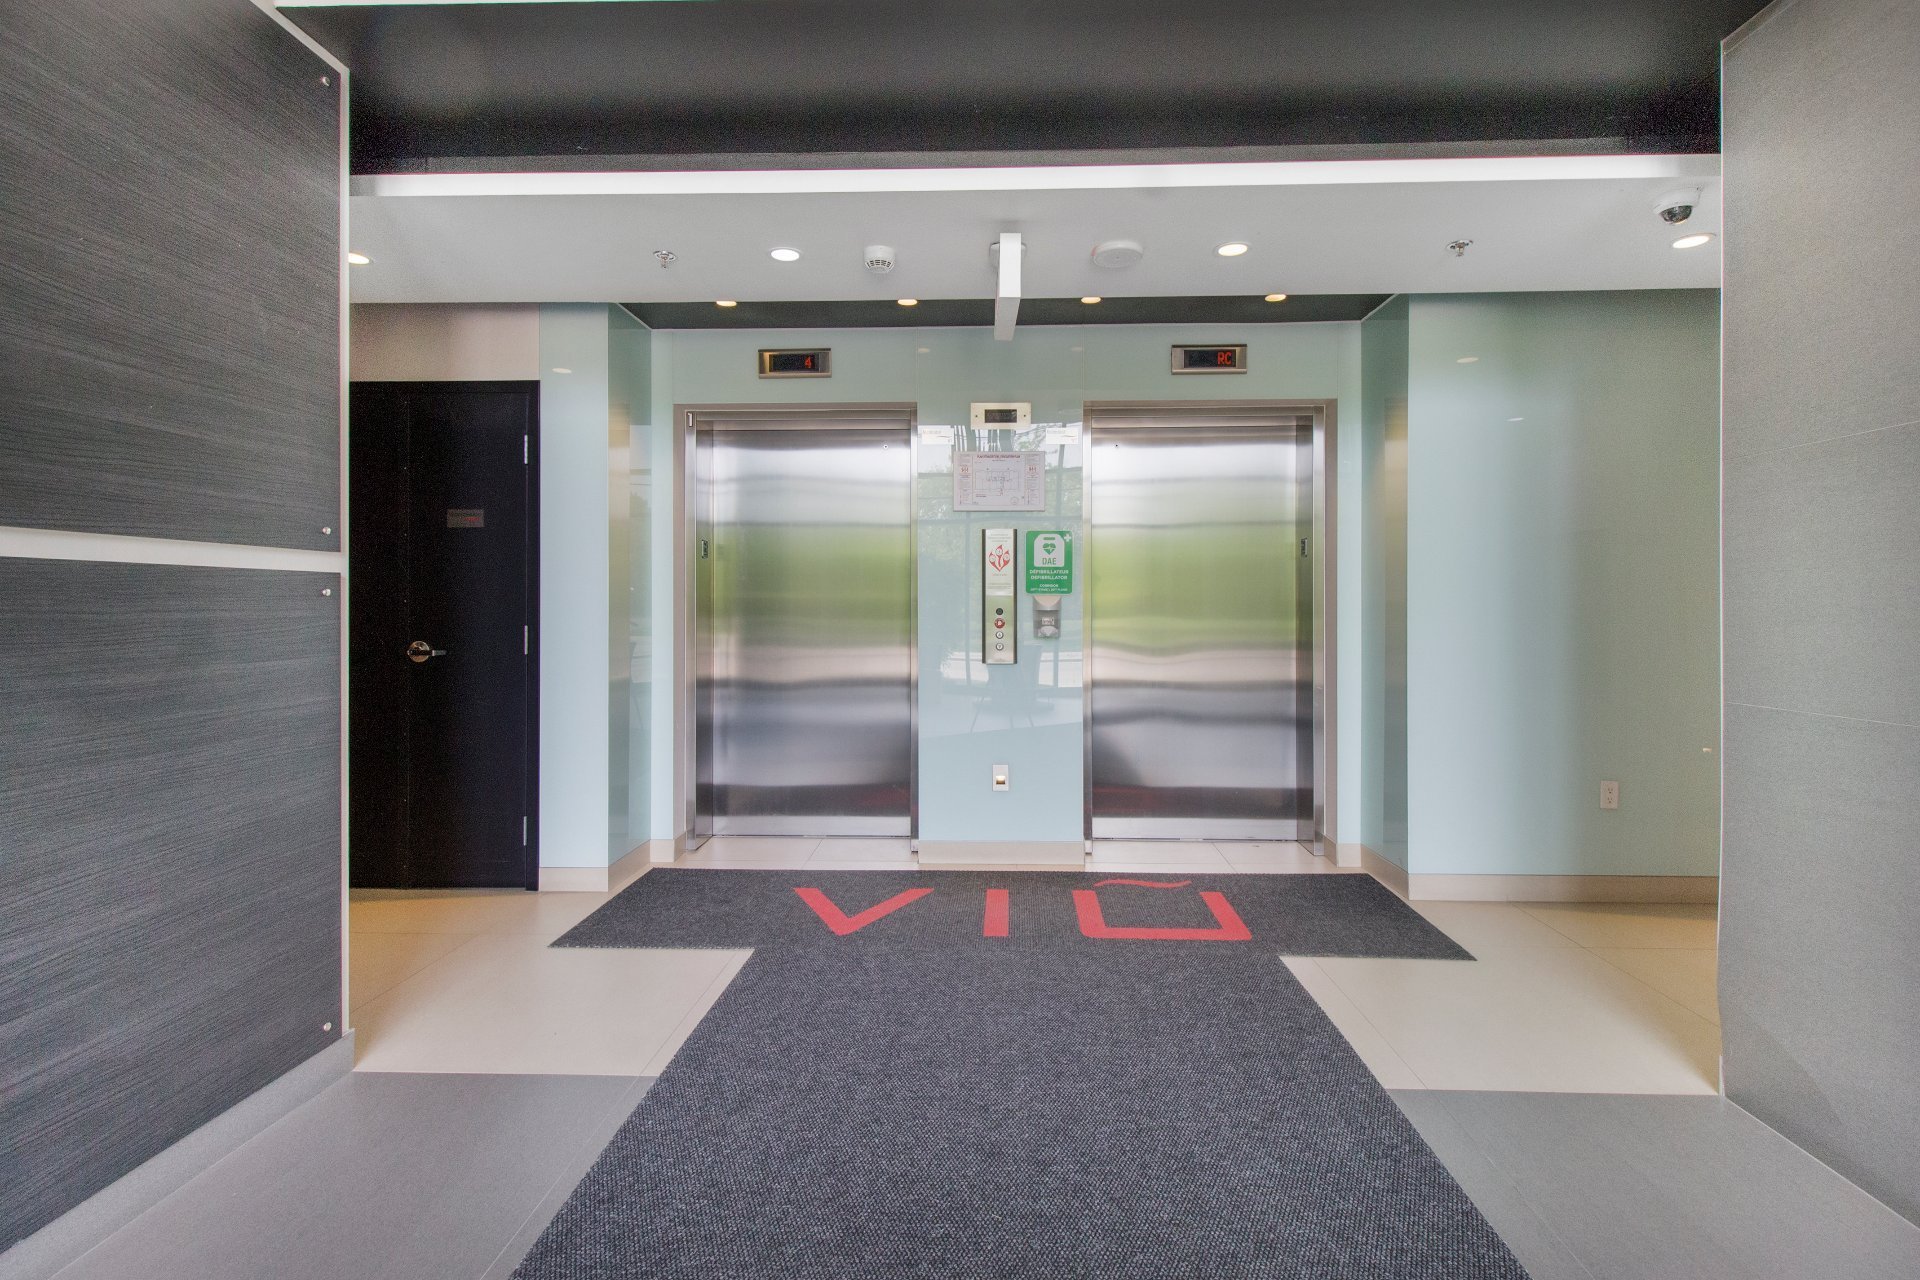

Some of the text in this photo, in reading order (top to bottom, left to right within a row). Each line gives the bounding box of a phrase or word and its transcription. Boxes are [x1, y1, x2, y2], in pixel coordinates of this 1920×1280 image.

[804, 356, 812, 369] 4
[1217, 351, 1232, 365] RC
[1042, 557, 1057, 565] DAE
